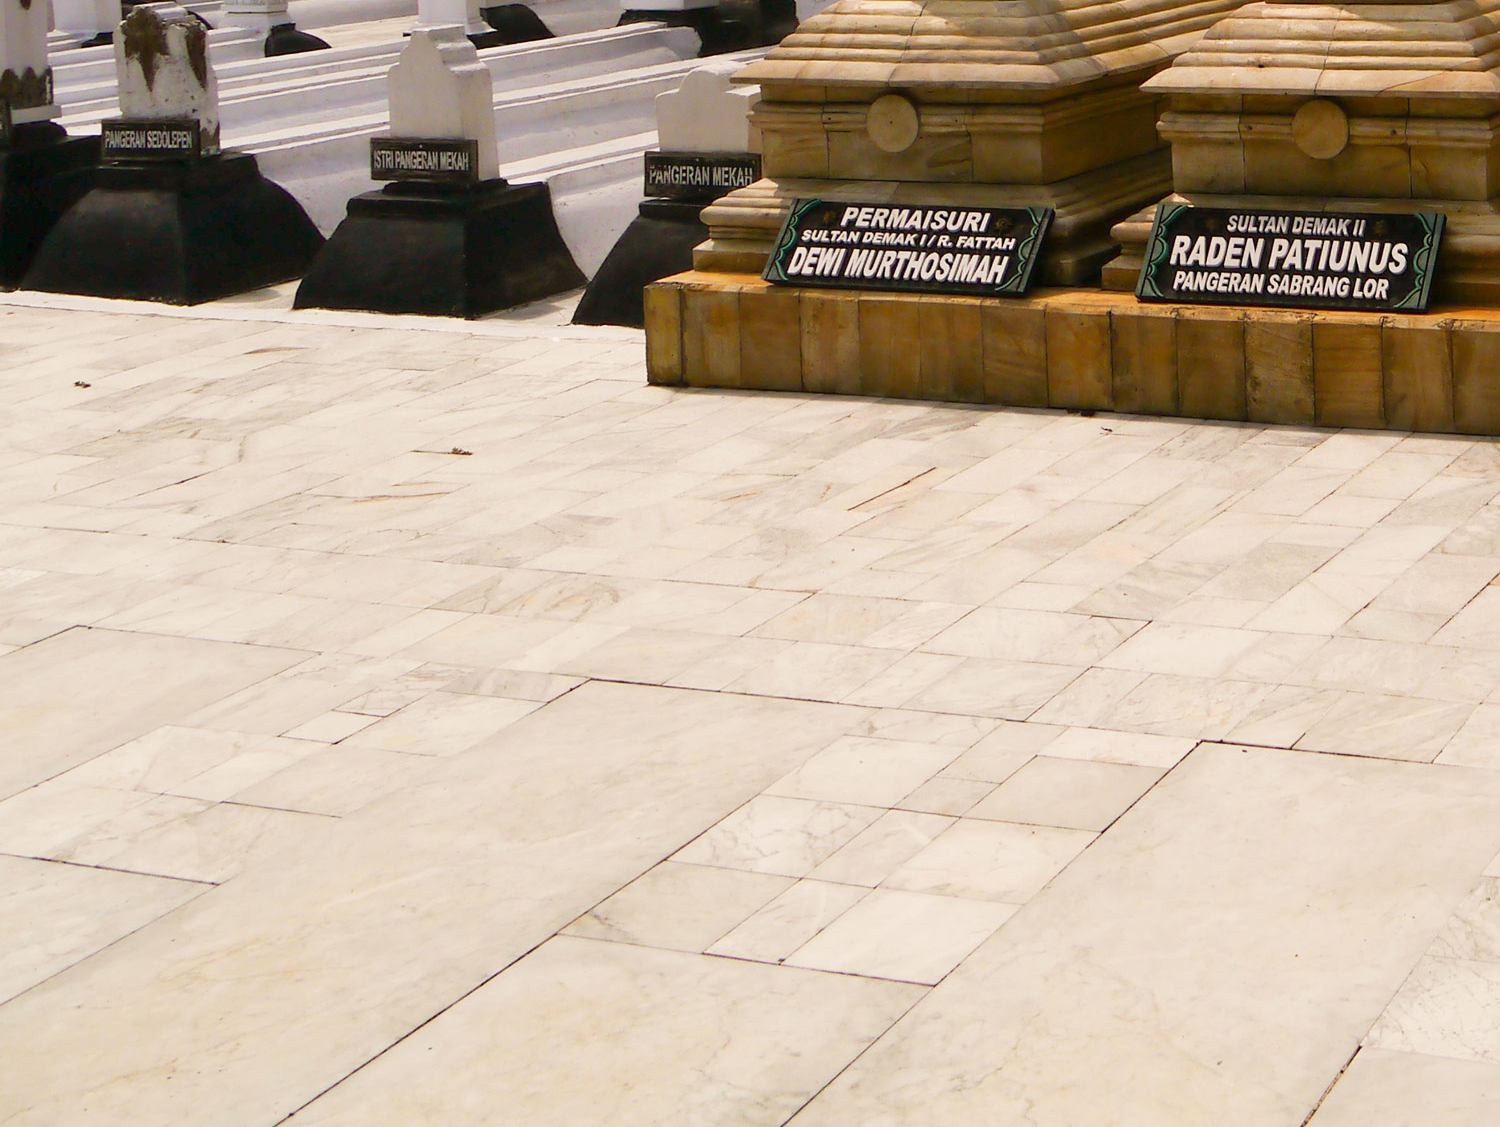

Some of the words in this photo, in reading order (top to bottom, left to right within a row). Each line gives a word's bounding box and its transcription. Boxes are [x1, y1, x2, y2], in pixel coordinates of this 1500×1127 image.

[105, 131, 145, 148] PANGERAN
[147, 130, 192, 149] SEDOLEPEN
[374, 150, 394, 169] ISTRI
[395, 150, 439, 171] PANGERAN
[440, 151, 469, 171] MEKAH
[649, 164, 710, 186] PANGERAN
[712, 166, 753, 187] MEKAH
[840, 206, 991, 233] PERMAISURI
[1226, 215, 1291, 235] SULTAN
[1291, 217, 1352, 236] DEMAK
[1352, 219, 1366, 237] II
[801, 229, 860, 244] SULTAN
[862, 231, 919, 247] DEMAK
[937, 235, 953, 249] R.
[956, 235, 1016, 251] FATTAH
[787, 246, 848, 277] DEWI
[845, 249, 1010, 284] MURTHOSIMAH
[1169, 235, 1266, 269] RADEN
[1268, 237, 1408, 274] PATIUNUS
[1172, 270, 1266, 294] PANGERAN
[1267, 273, 1351, 298] SABRANG
[1352, 277, 1390, 301] LOR
